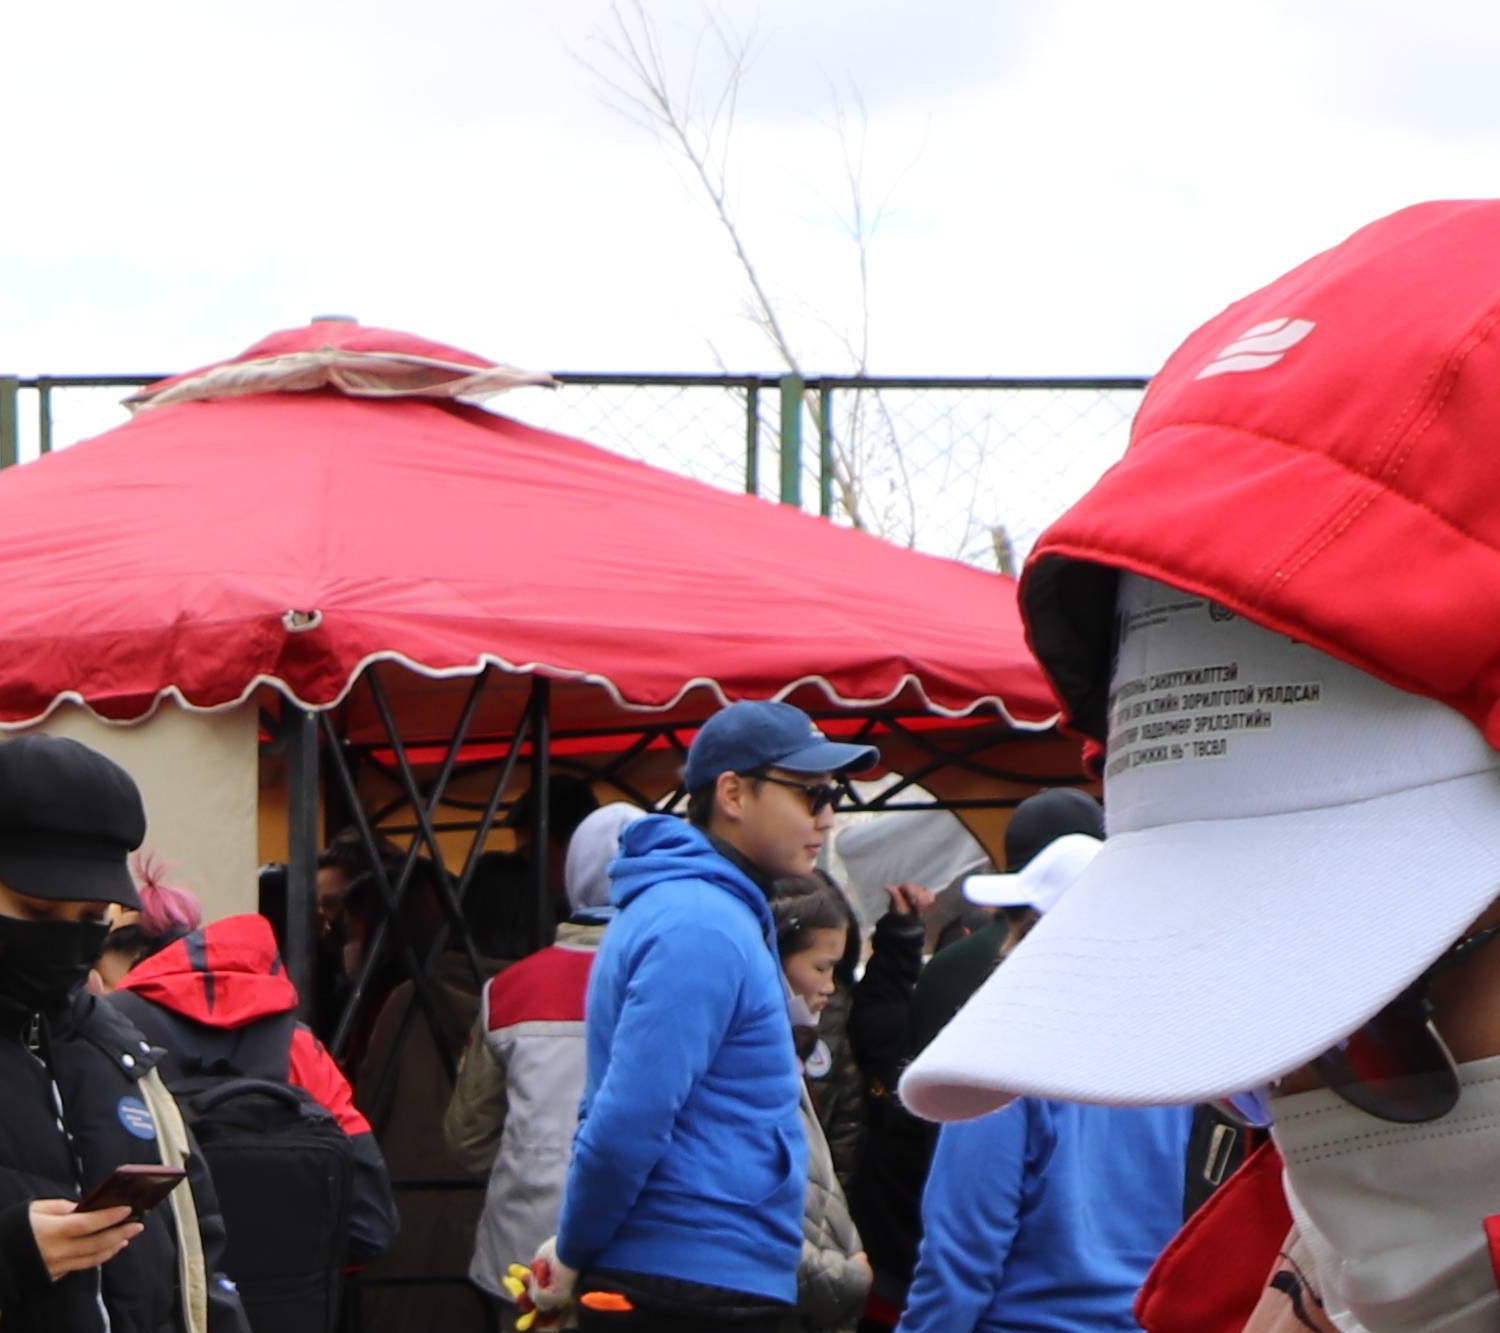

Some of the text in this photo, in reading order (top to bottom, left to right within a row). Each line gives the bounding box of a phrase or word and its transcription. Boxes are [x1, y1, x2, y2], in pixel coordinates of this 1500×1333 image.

[1182, 685, 1255, 711] ЗОРИЛГОТОЙ
[1257, 684, 1320, 704] УЯЛДСАН
[1195, 709, 1272, 733] ЭРХЛЭЛТИЙН
